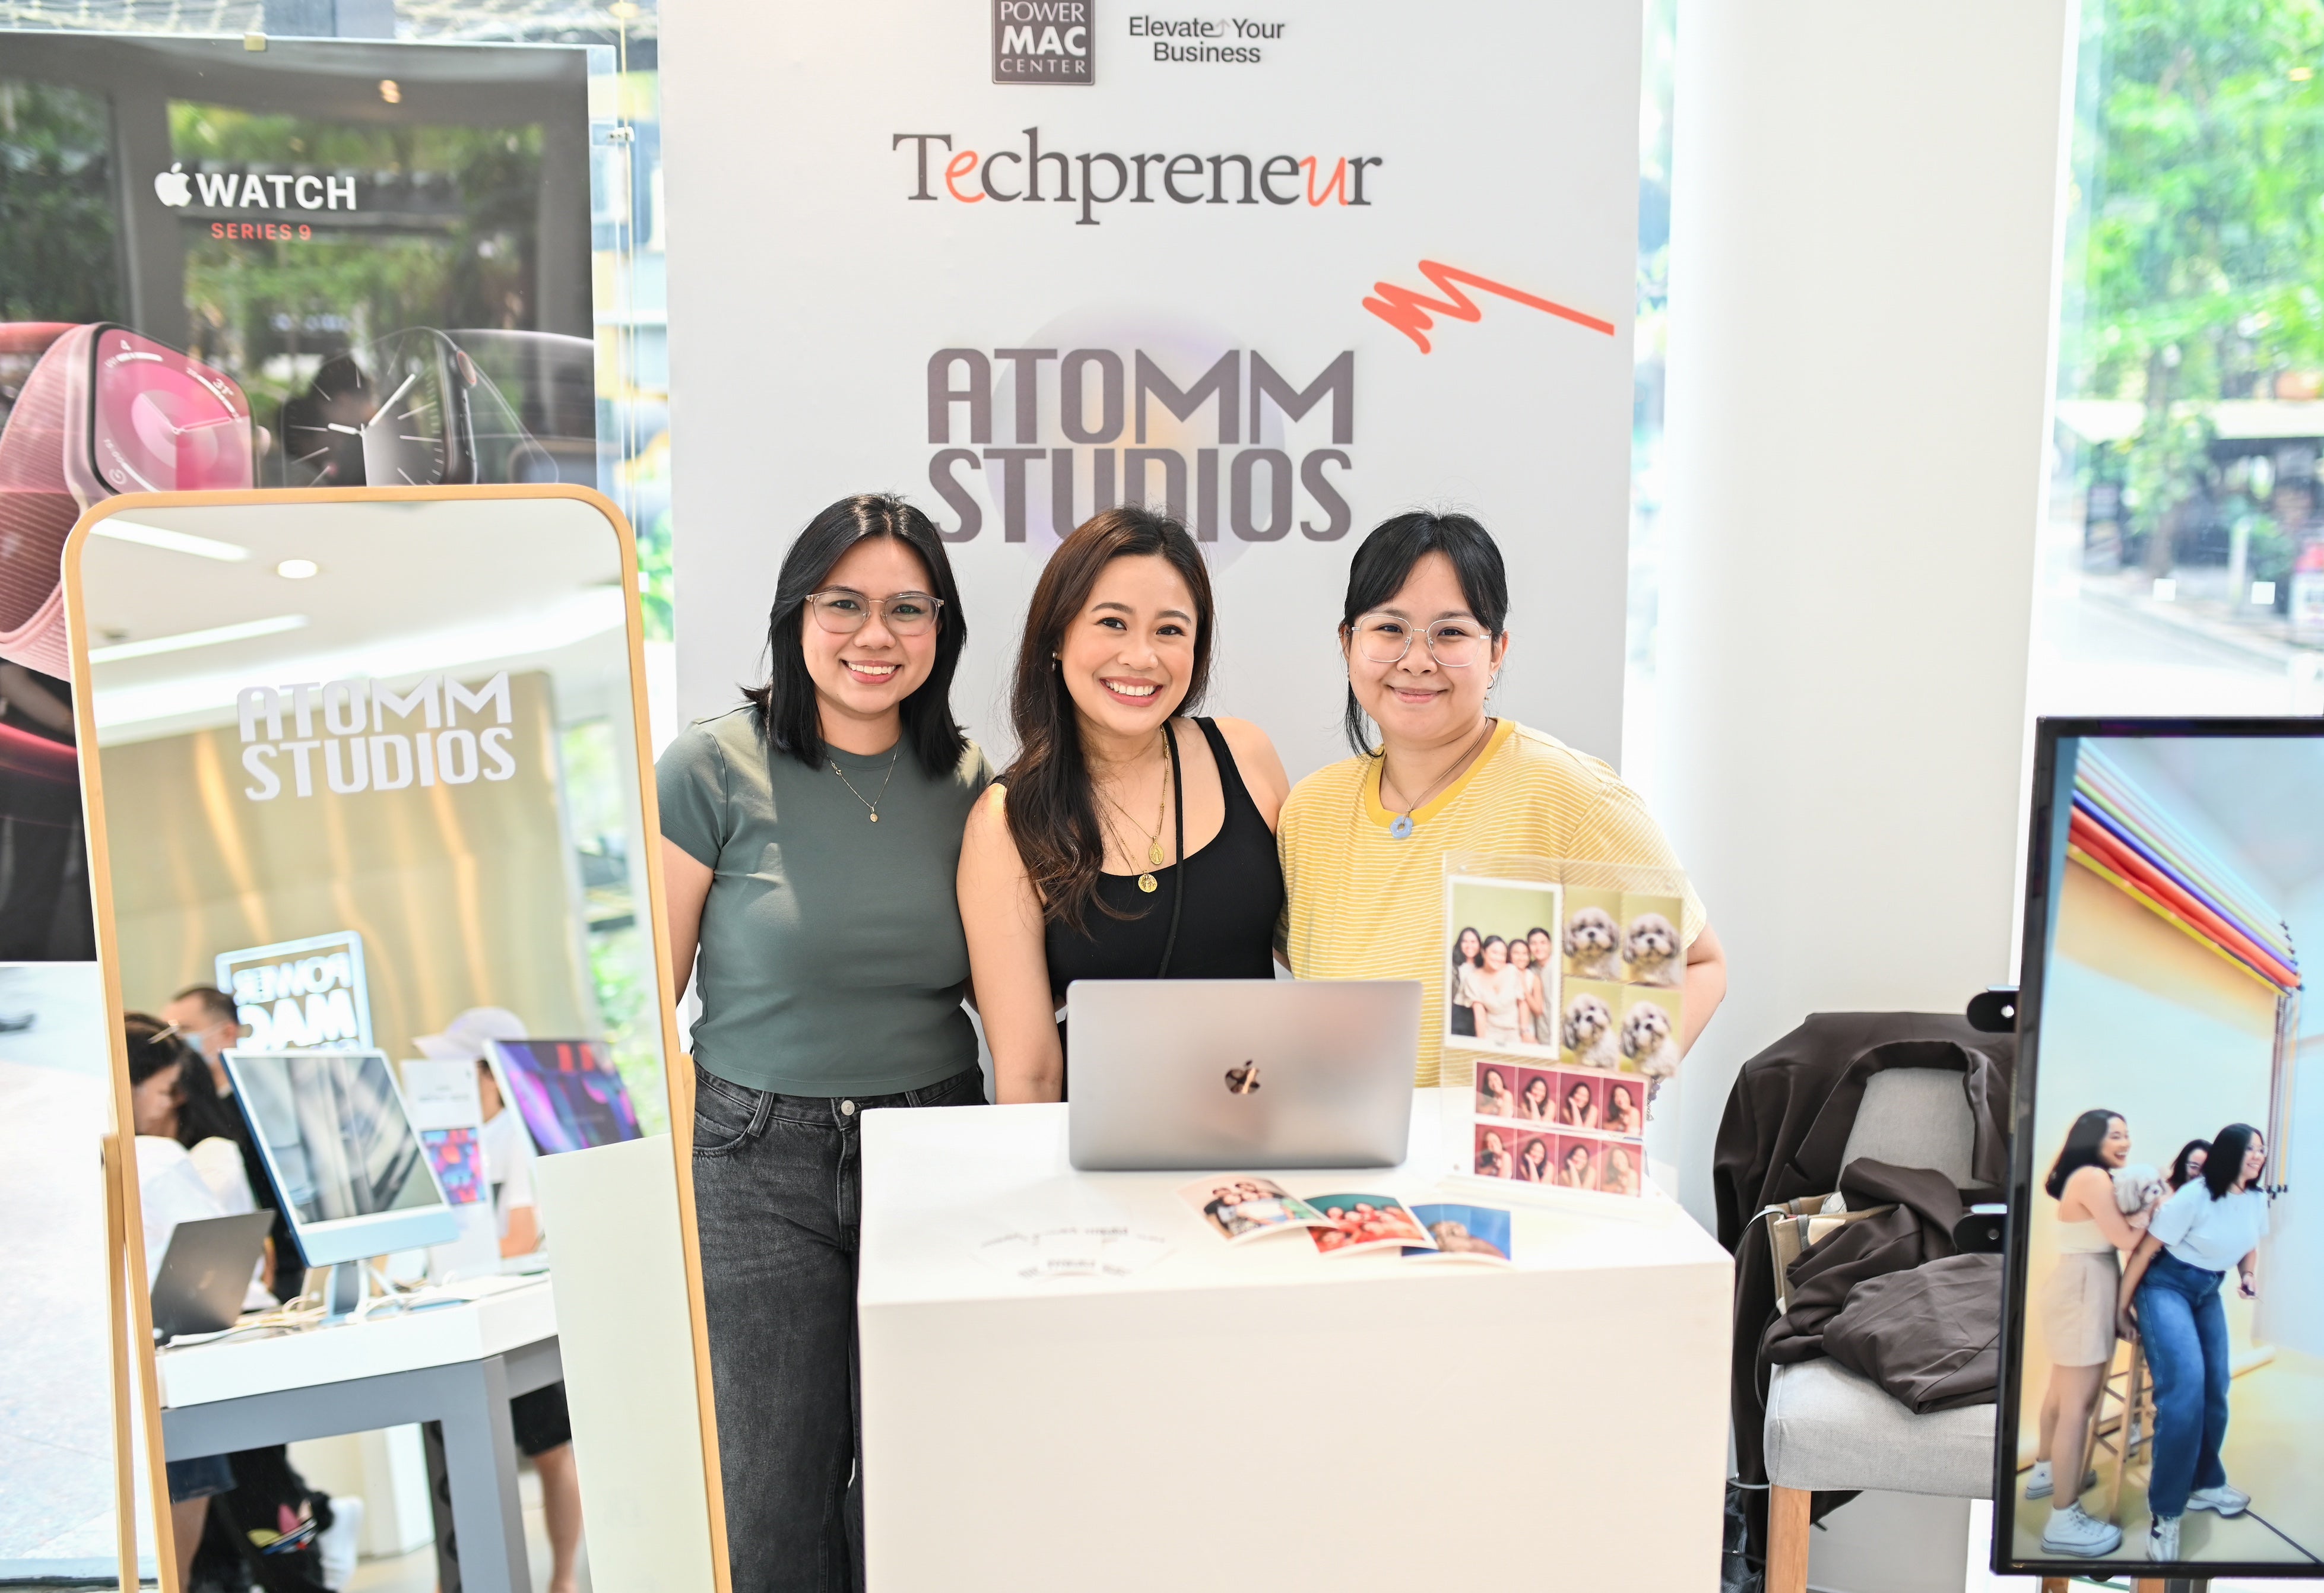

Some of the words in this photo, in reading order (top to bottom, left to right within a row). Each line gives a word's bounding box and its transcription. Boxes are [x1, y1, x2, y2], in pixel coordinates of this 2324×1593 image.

[1000, 1, 1085, 22] POWER
[1130, 17, 1215, 37] Elevate
[1232, 18, 1285, 39] Your
[1001, 26, 1086, 56] MAC
[1153, 42, 1261, 63] Business
[1001, 59, 1086, 73] CENTER
[195, 173, 356, 210] WATCH
[893, 126, 1383, 226] Techpreneur
[211, 223, 291, 240] SERIES
[299, 224, 312, 241] 9
[927, 348, 1354, 445] ATOMM
[928, 448, 1352, 543] STUDIOS
[237, 671, 513, 742] ATOMM
[241, 726, 516, 801] STUDIOS
